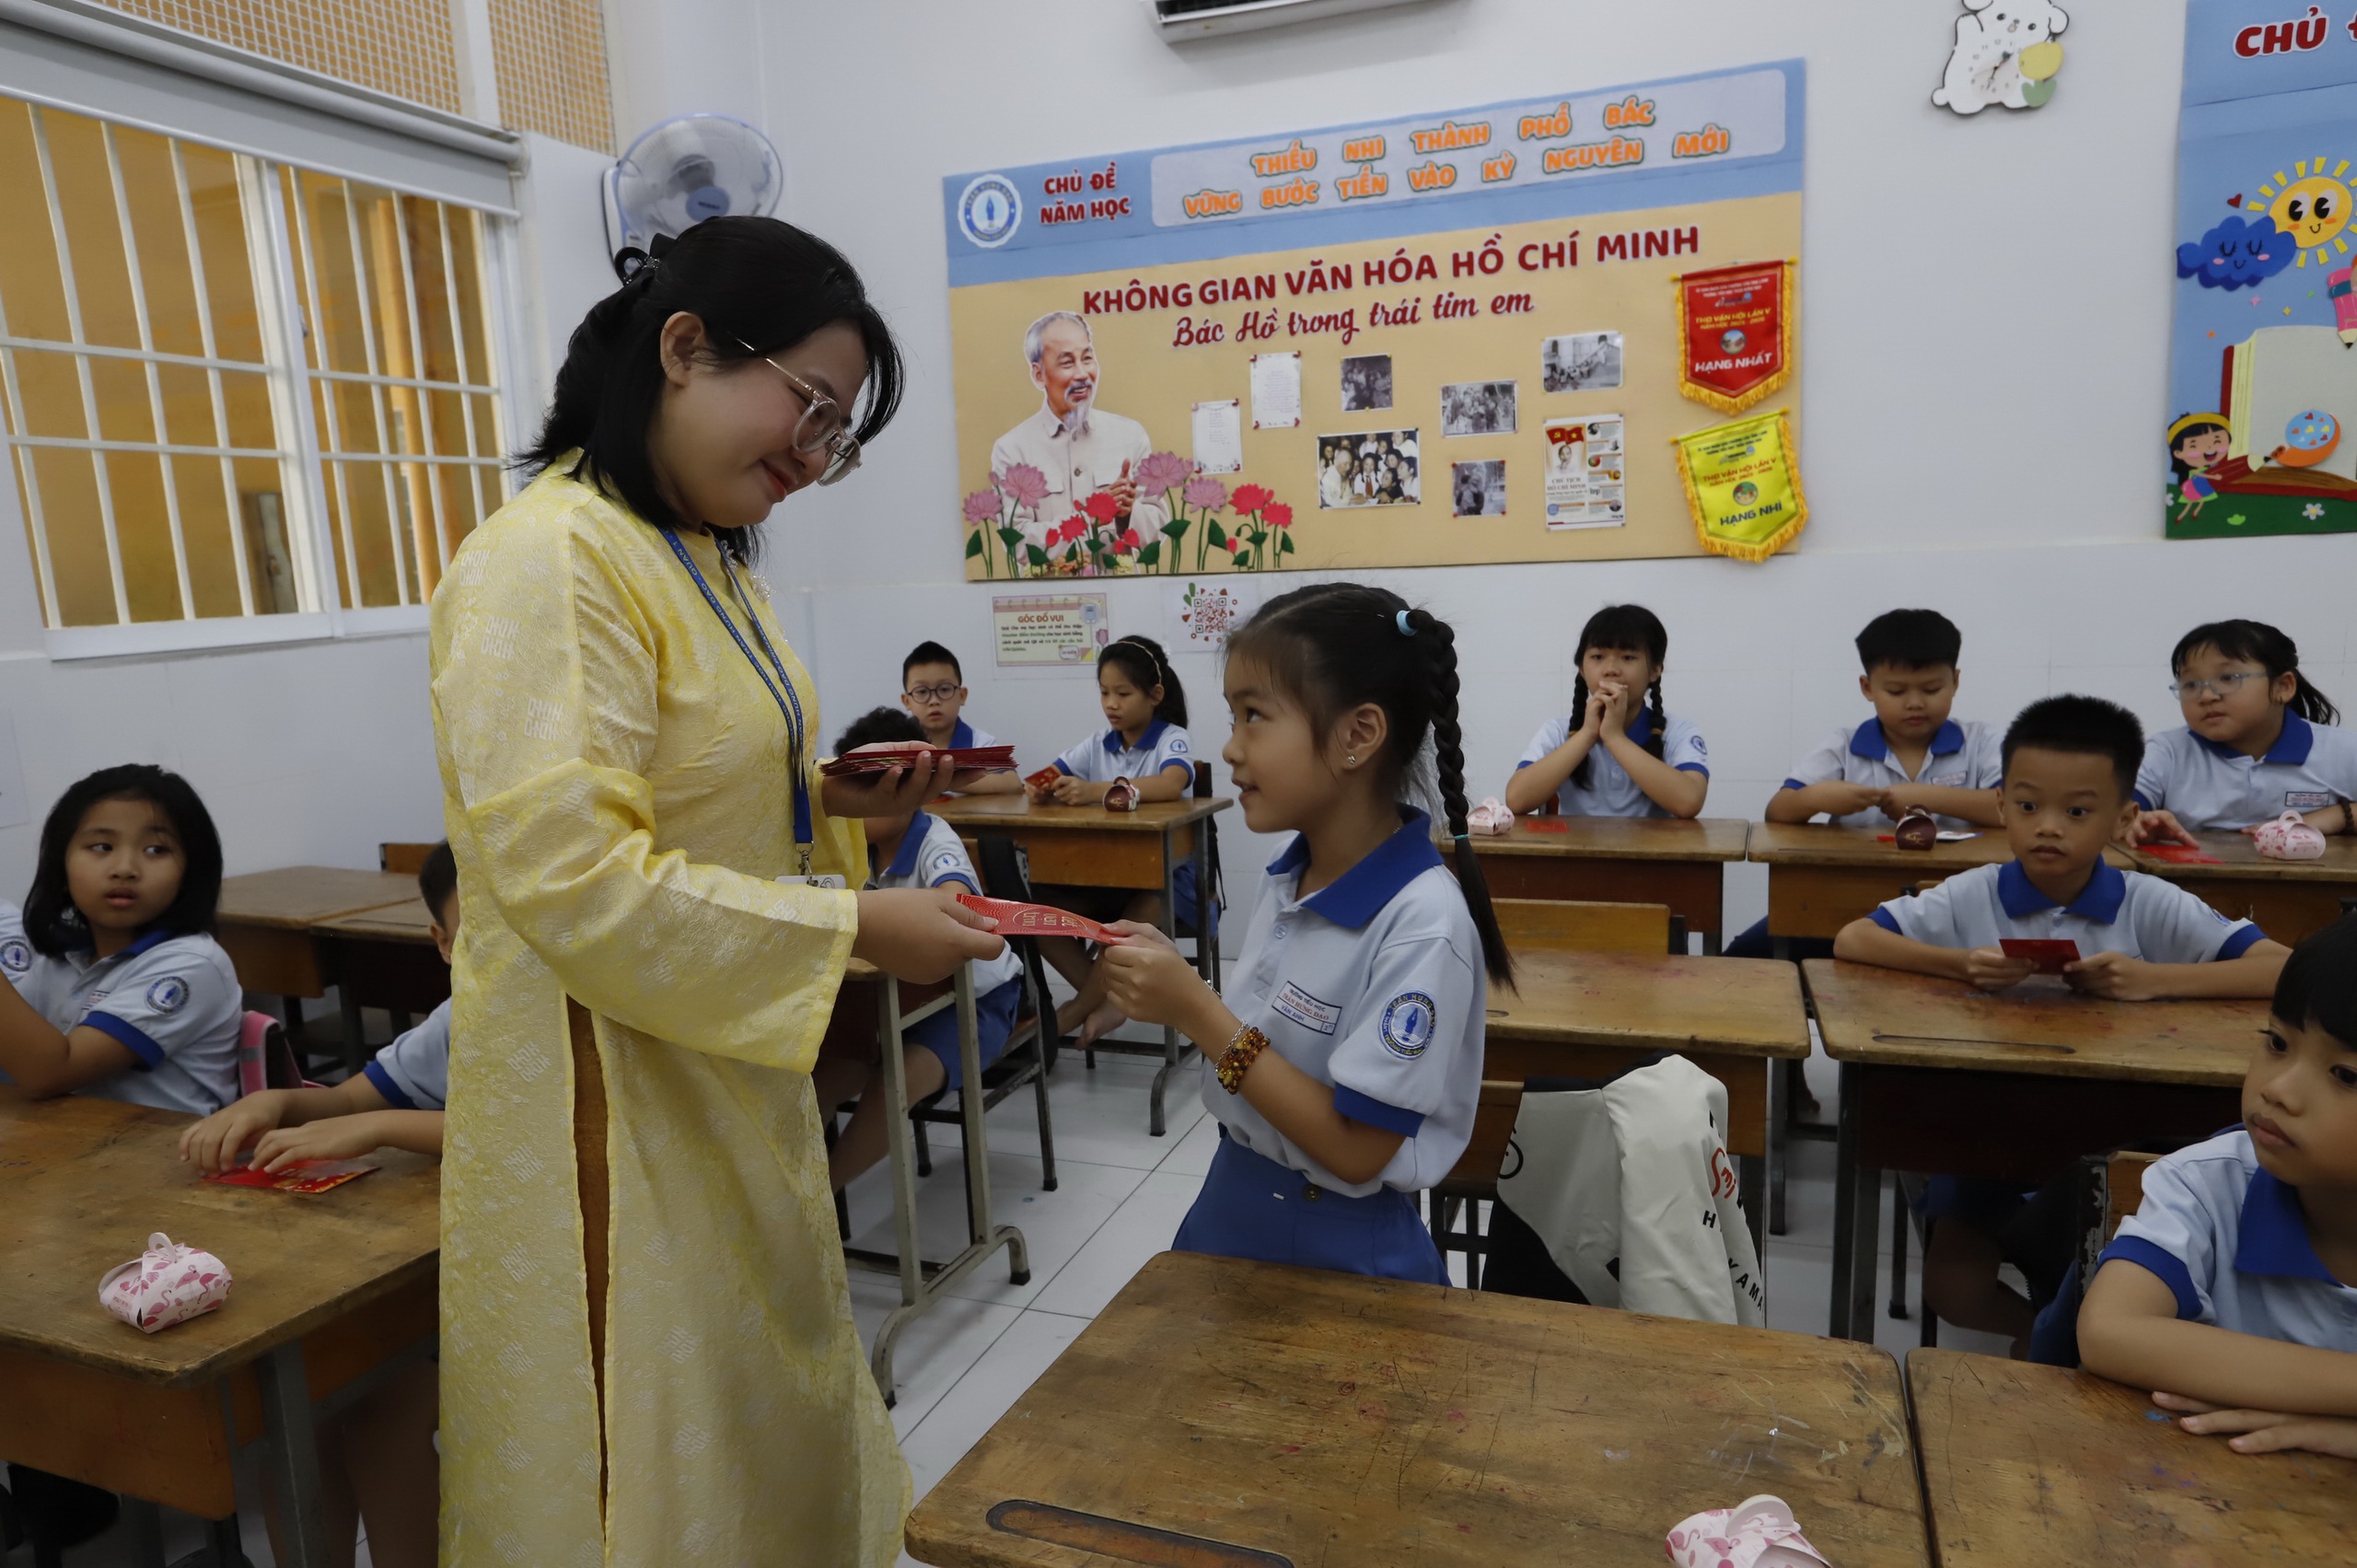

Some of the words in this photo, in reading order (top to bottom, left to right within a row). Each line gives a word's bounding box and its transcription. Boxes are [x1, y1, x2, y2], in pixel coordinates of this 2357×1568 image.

[2235, 6, 2327, 57] CHỦ
[1250, 139, 1318, 179] THIẾU
[1342, 134, 1385, 163] NHI
[1411, 120, 1491, 154] THÀNH
[1518, 101, 1572, 141] PHỐ
[1603, 95, 1655, 131] BÁC
[1044, 169, 1083, 194] CHỦ
[1089, 161, 1117, 191] ĐỀ
[1183, 188, 1242, 218] VỮNG
[1260, 178, 1319, 210] BƯỚC
[1336, 162, 1387, 202] TIẾN
[1408, 160, 1457, 192] VÀO
[1542, 135, 1643, 174] NGUYÊN
[1672, 122, 1730, 158] MỚI
[1039, 200, 1086, 226] NĂM
[1090, 195, 1131, 222] HỌC
[1083, 278, 1193, 314] KHÔNG
[1198, 273, 1276, 305] GIAN
[1284, 260, 1353, 296] VĂN
[1364, 248, 1437, 285] HÓA
[1451, 233, 1504, 277] HỒ
[1518, 230, 1580, 272] CHÍ
[1597, 226, 1699, 262] MINH
[1173, 317, 1225, 347] Bác
[1236, 308, 1279, 341] Hồ
[1288, 309, 1360, 344] trong
[1369, 297, 1421, 327] trái
[1432, 293, 1479, 320] tim
[1491, 292, 1534, 315] em
[1695, 358, 1733, 374] HẠNG
[1736, 351, 1772, 369] NHẤT
[1720, 509, 1756, 527] HẠNG
[1759, 500, 1782, 517] NHÌ
[1018, 613, 1035, 623] GÓC
[1037, 612, 1049, 622] ĐỐ
[1051, 614, 1064, 622] VUI
